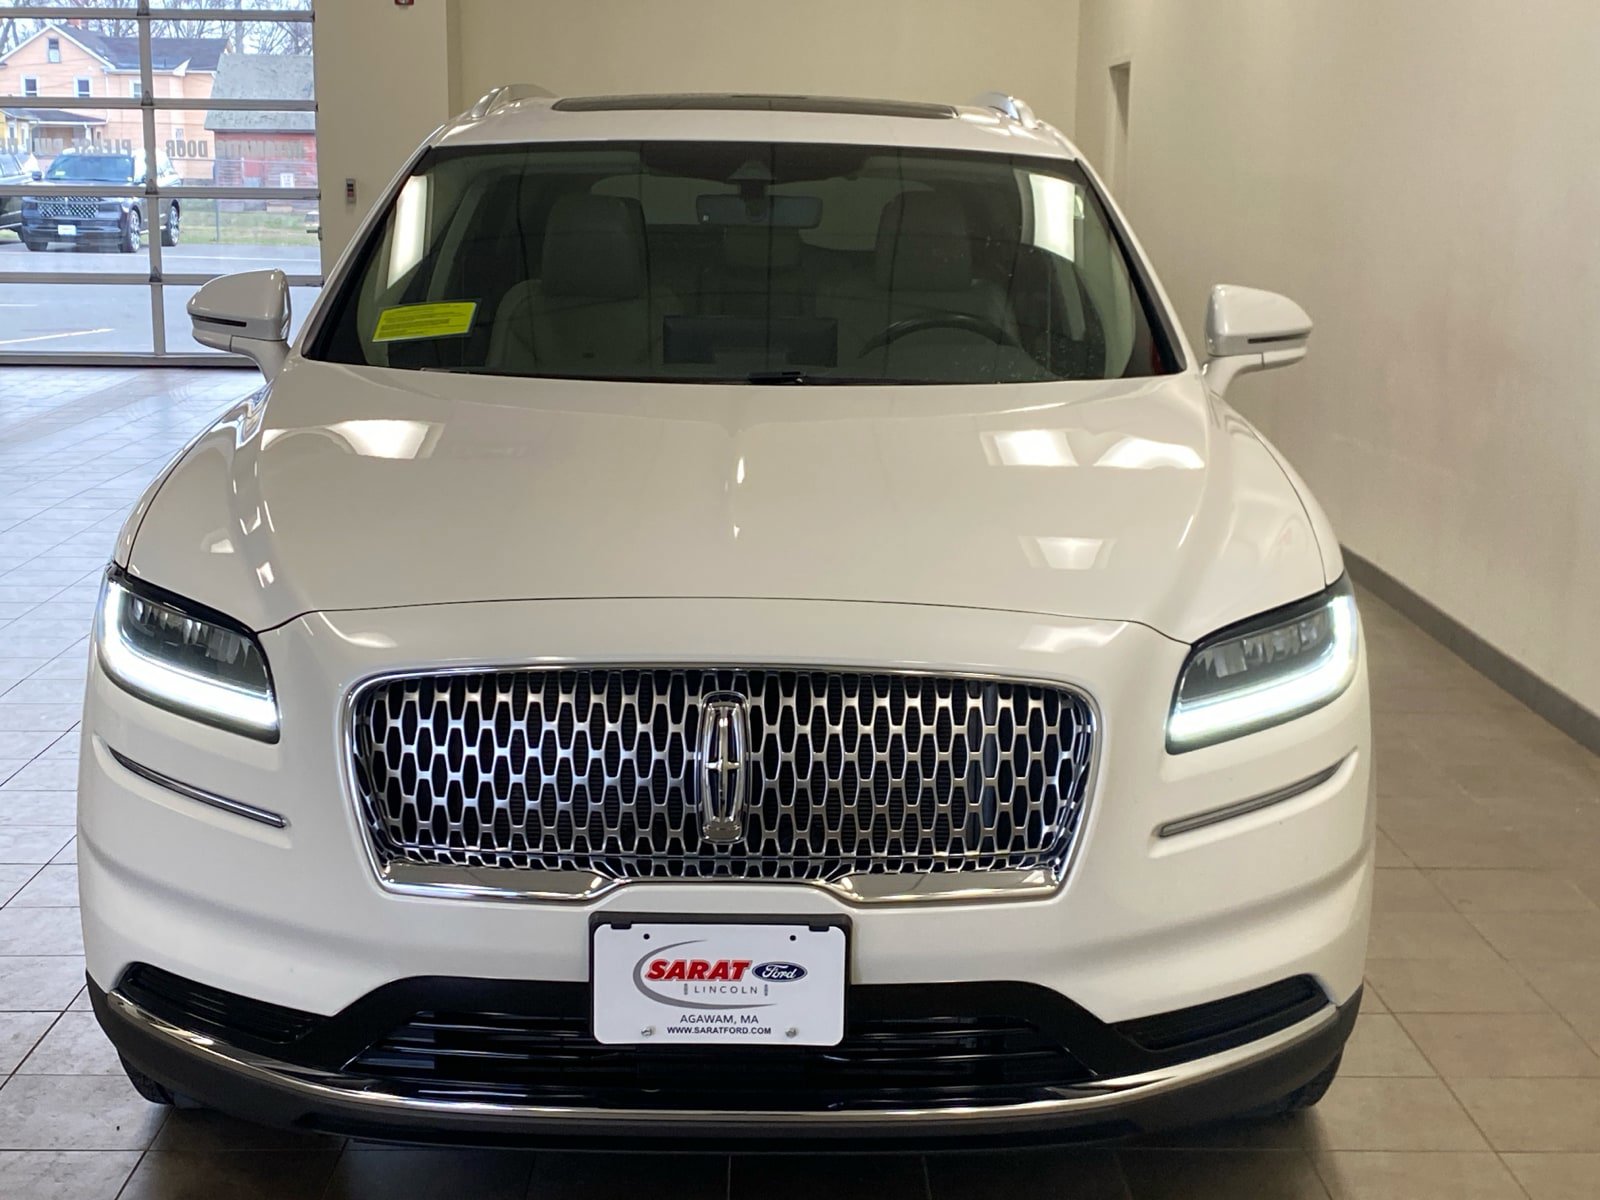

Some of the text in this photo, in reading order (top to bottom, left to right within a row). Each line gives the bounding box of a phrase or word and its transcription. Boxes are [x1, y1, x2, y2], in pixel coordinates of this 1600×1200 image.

[645, 959, 796, 981] SARAT Ford
[694, 985, 758, 994] LINCOLN
[680, 1014, 759, 1024] AGAWAM, MA
[667, 1026, 772, 1035] WWW.SARATFORD.COM
